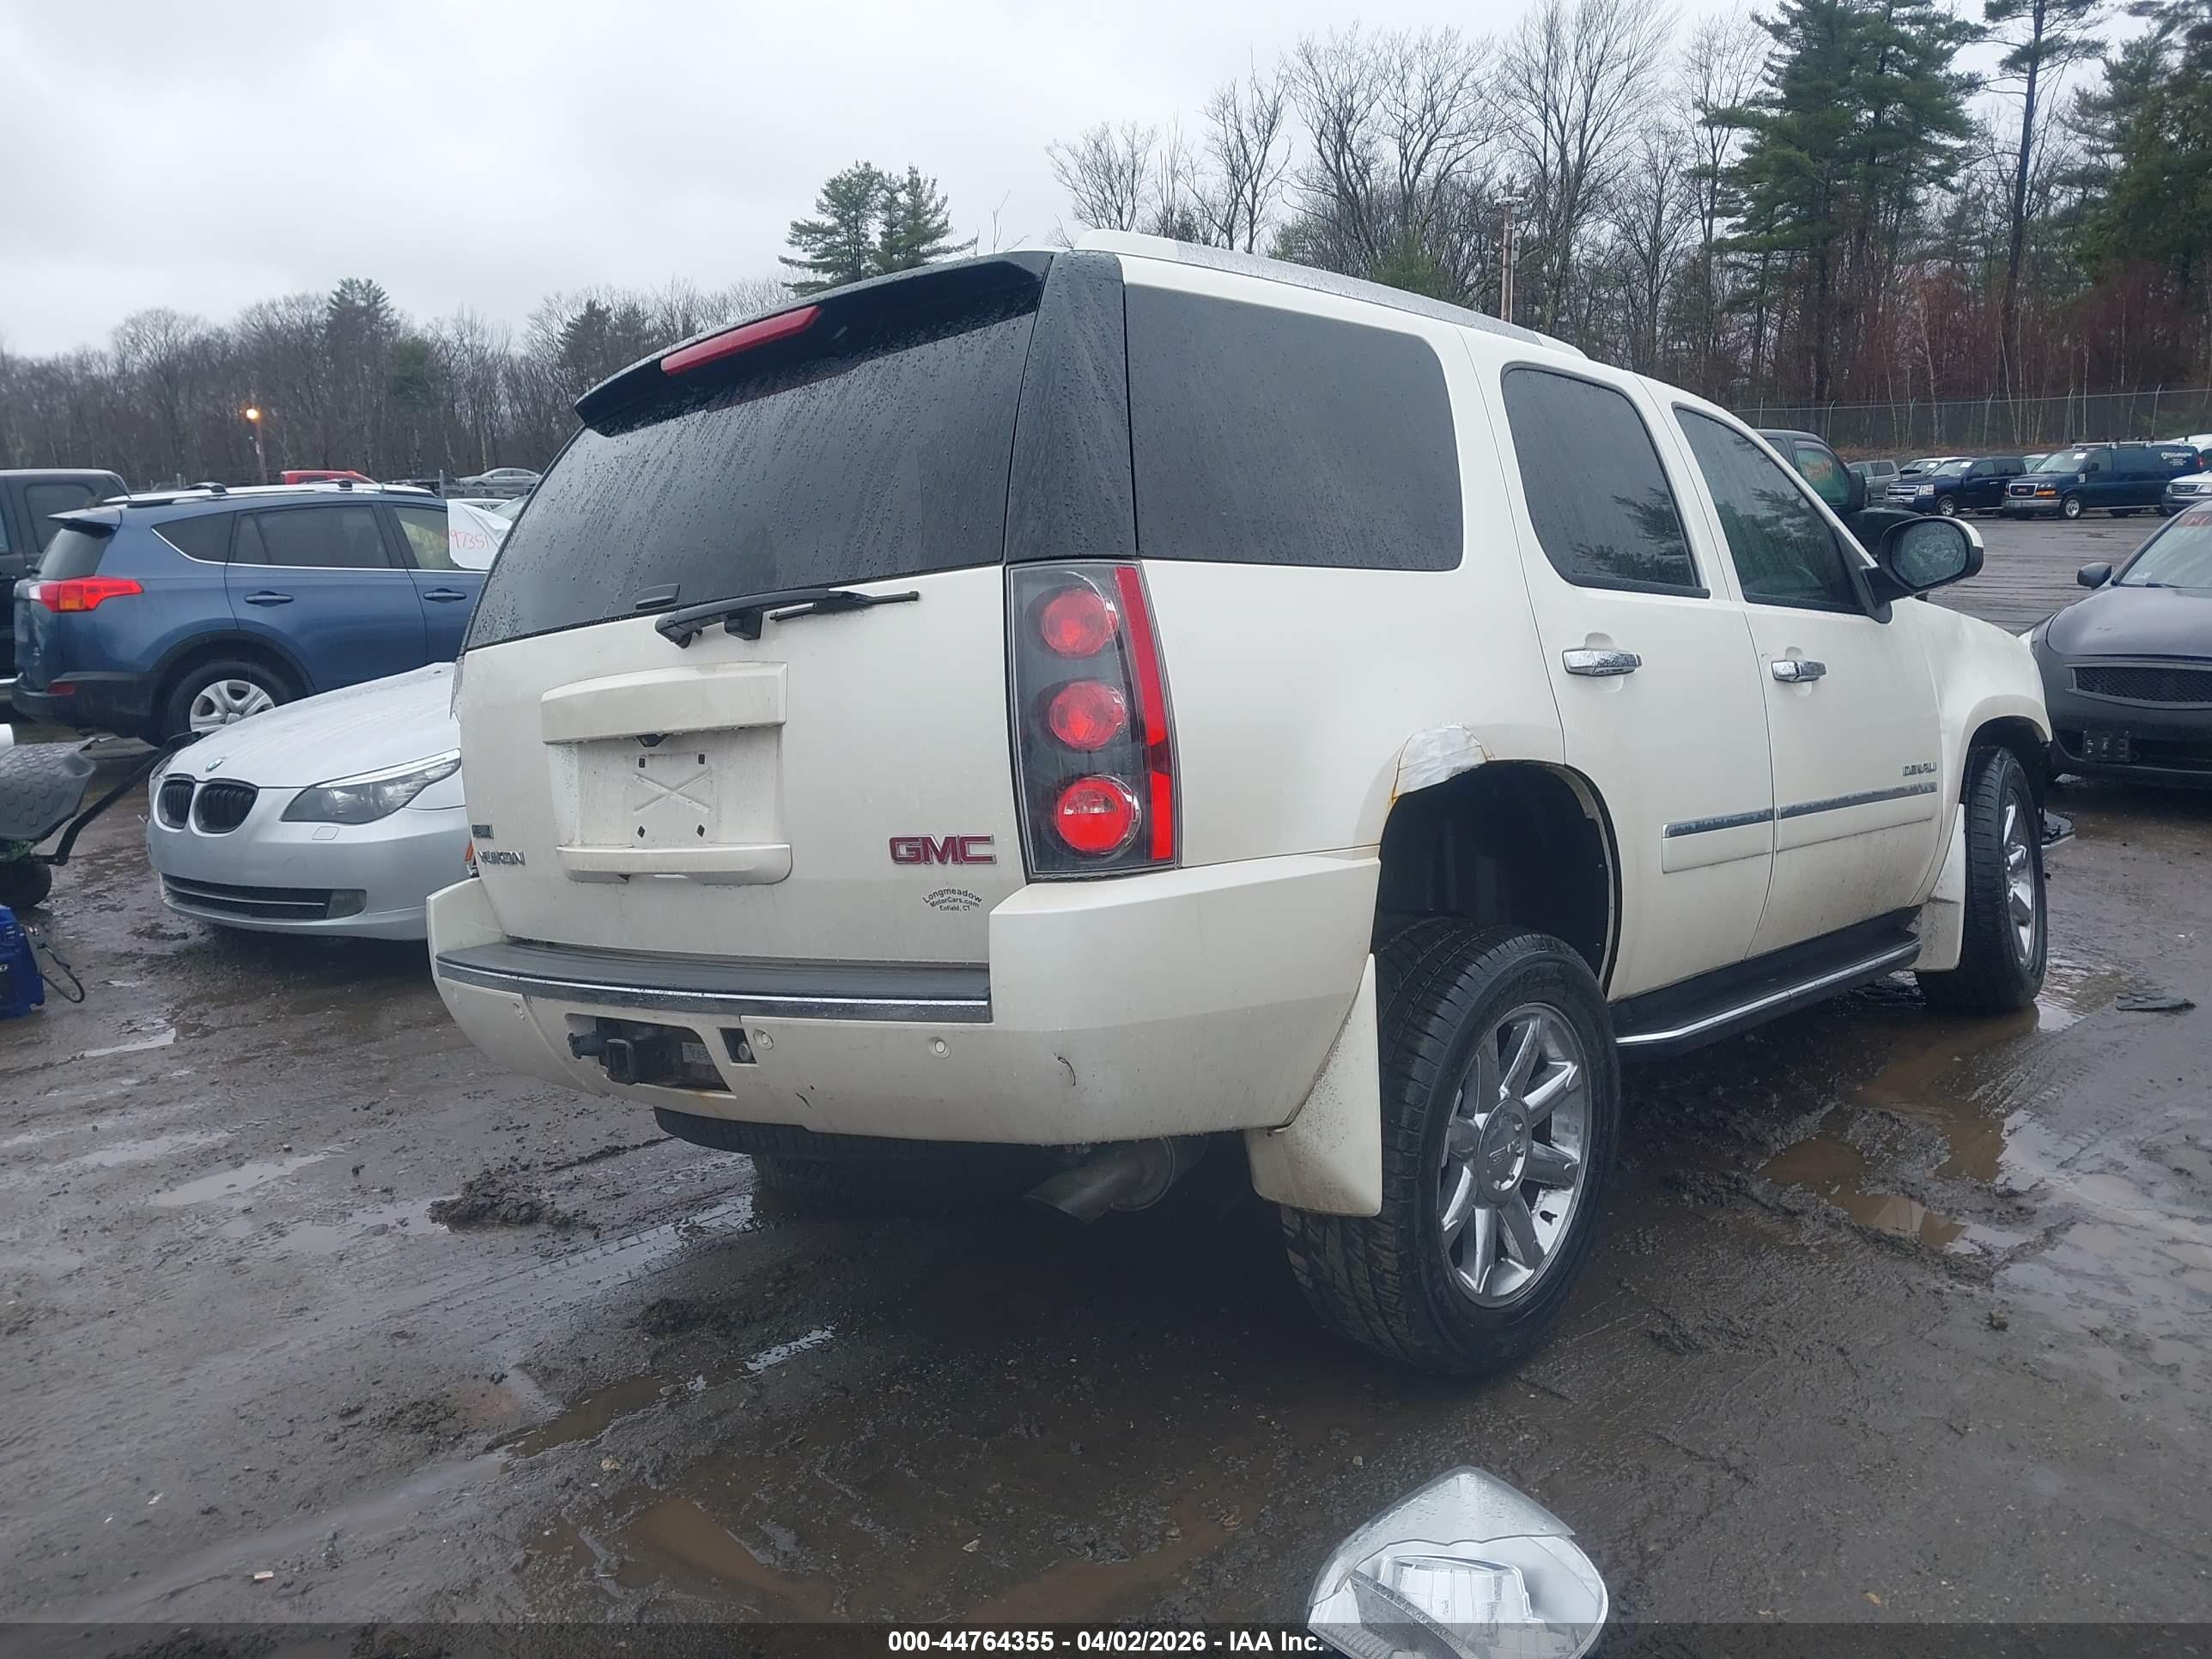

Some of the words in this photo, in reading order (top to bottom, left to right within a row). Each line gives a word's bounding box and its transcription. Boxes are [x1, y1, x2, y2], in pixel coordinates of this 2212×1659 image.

[887, 833, 997, 865] GMC
[476, 850, 526, 866] YUKON
[922, 888, 983, 905] Longmeadow
[930, 896, 981, 908] MotorCars.com
